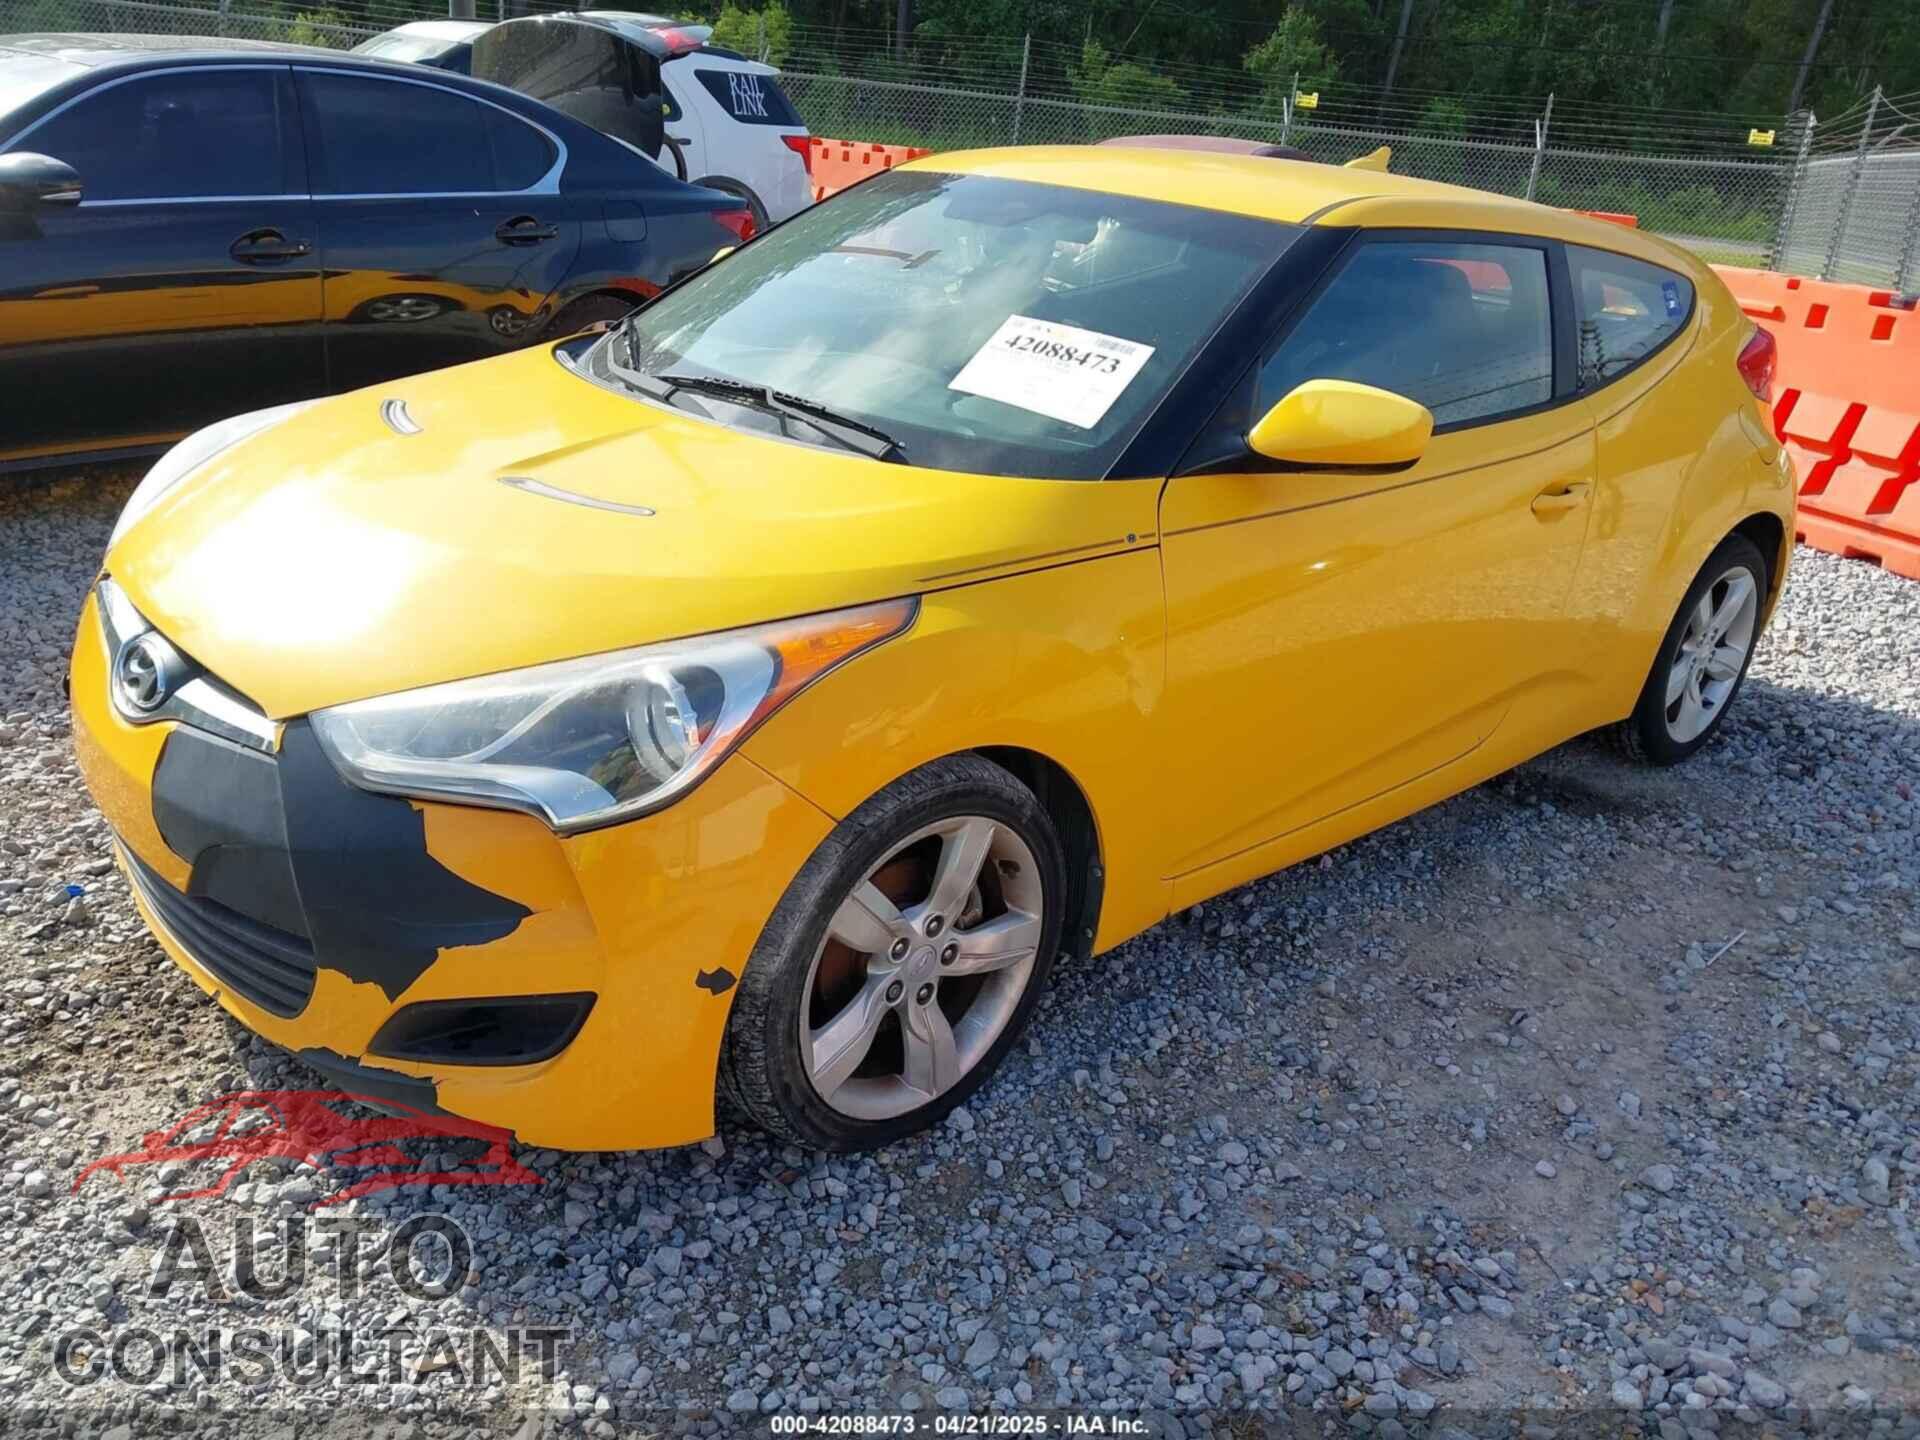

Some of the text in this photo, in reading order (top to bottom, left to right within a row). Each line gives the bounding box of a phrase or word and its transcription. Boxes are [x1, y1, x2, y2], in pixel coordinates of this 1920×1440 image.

[728, 73, 764, 95] RAIL
[731, 92, 769, 117] LINK
[1005, 335, 1121, 373] 42088473
